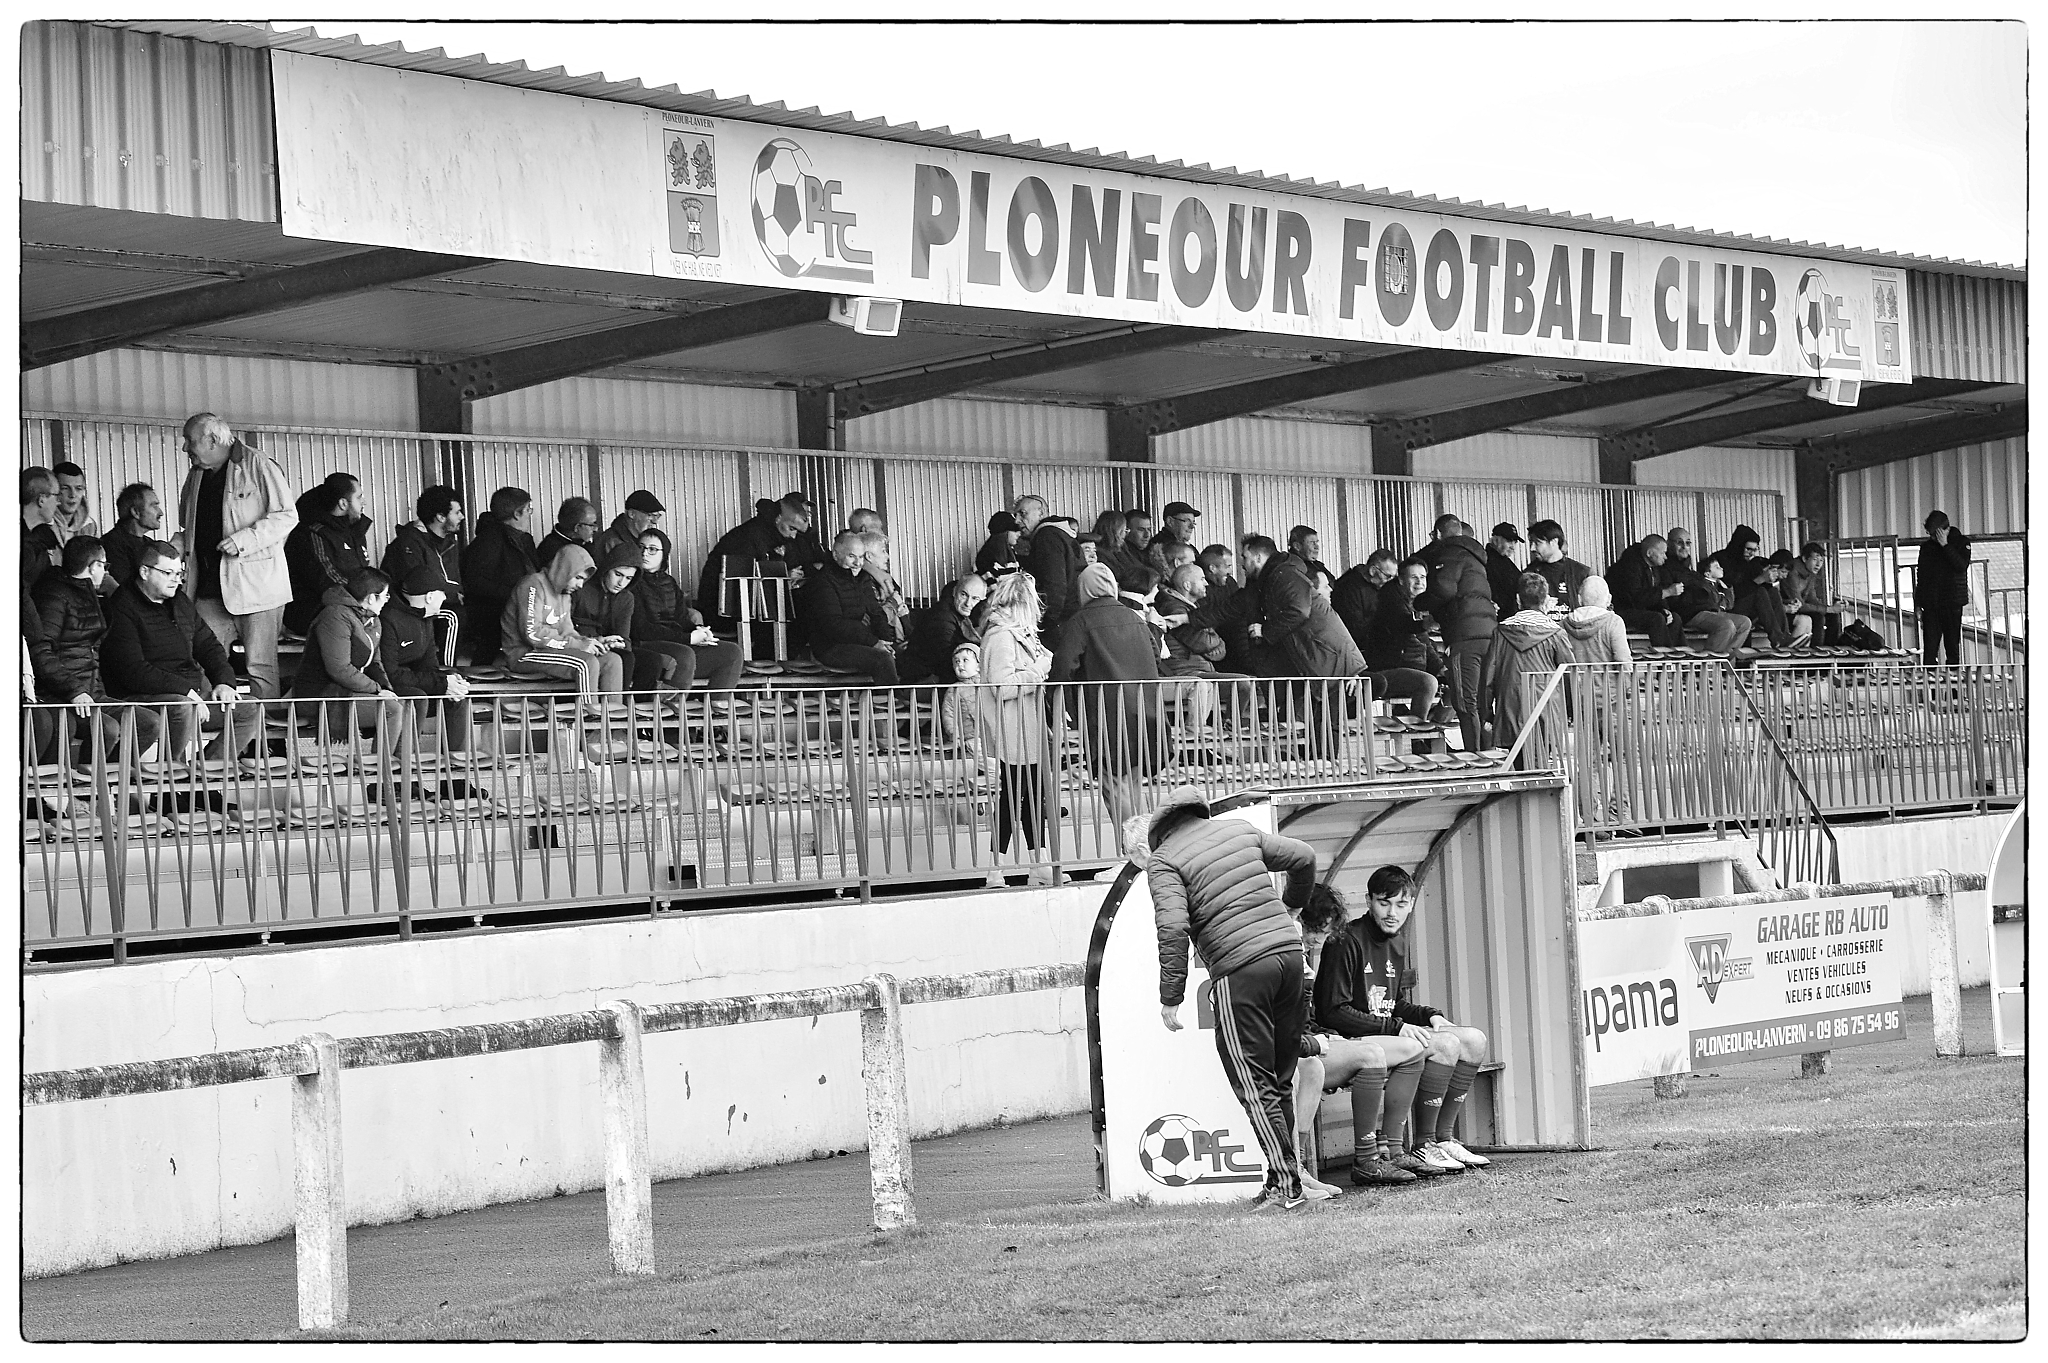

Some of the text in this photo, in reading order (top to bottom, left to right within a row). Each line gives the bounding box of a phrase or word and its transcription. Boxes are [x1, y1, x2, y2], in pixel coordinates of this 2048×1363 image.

[911, 163, 1777, 356] PLONEOUR FOOTBALL CLUB
[1757, 904, 1888, 943] GARAGE RB AUTO
[1697, 943, 1724, 988] AD
[1765, 939, 1883, 965] MECANIQUE CARROSSERIE
[1787, 961, 1866, 983] VENTES VEHICULES
[1785, 980, 1871, 1004] NEUFS & OCCASIONS
[1695, 1023, 1806, 1058] PLONEOUR-LANVERN
[1816, 1020, 1831, 1040] 09
[1834, 1018, 1848, 1037] 86
[1851, 1015, 1865, 1035] 75
[1867, 1012, 1882, 1032] 54
[1884, 1010, 1899, 1030] 96
